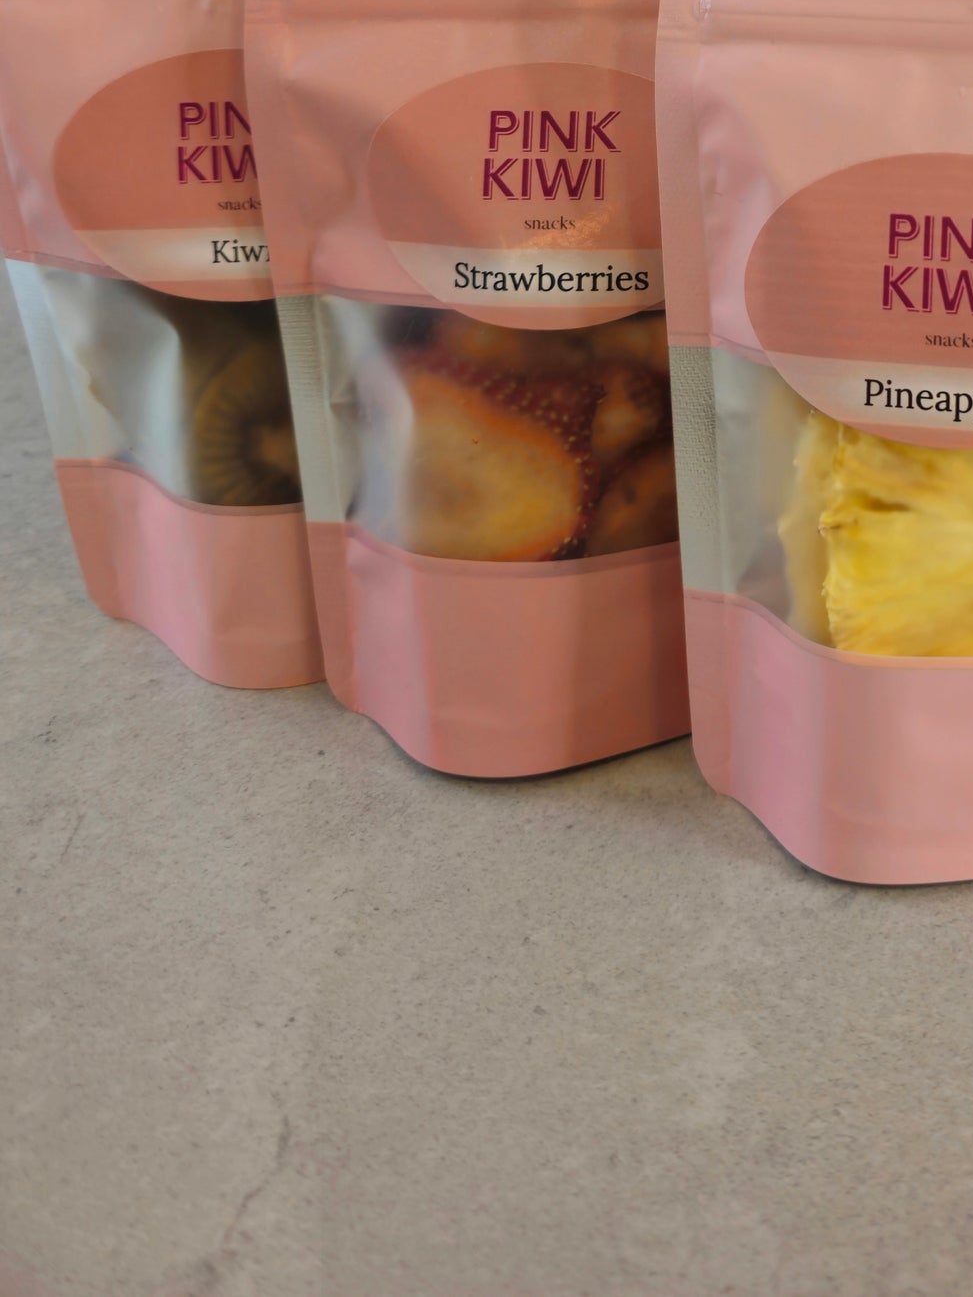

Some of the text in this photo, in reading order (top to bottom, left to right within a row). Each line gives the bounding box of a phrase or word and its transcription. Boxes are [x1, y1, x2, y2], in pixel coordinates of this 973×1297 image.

[178, 101, 252, 140] PIN
[488, 110, 621, 152] PINK
[177, 144, 258, 184] KIW
[482, 158, 605, 201] KIWI
[524, 216, 576, 230] snacks
[454, 261, 649, 292] Strawberries
